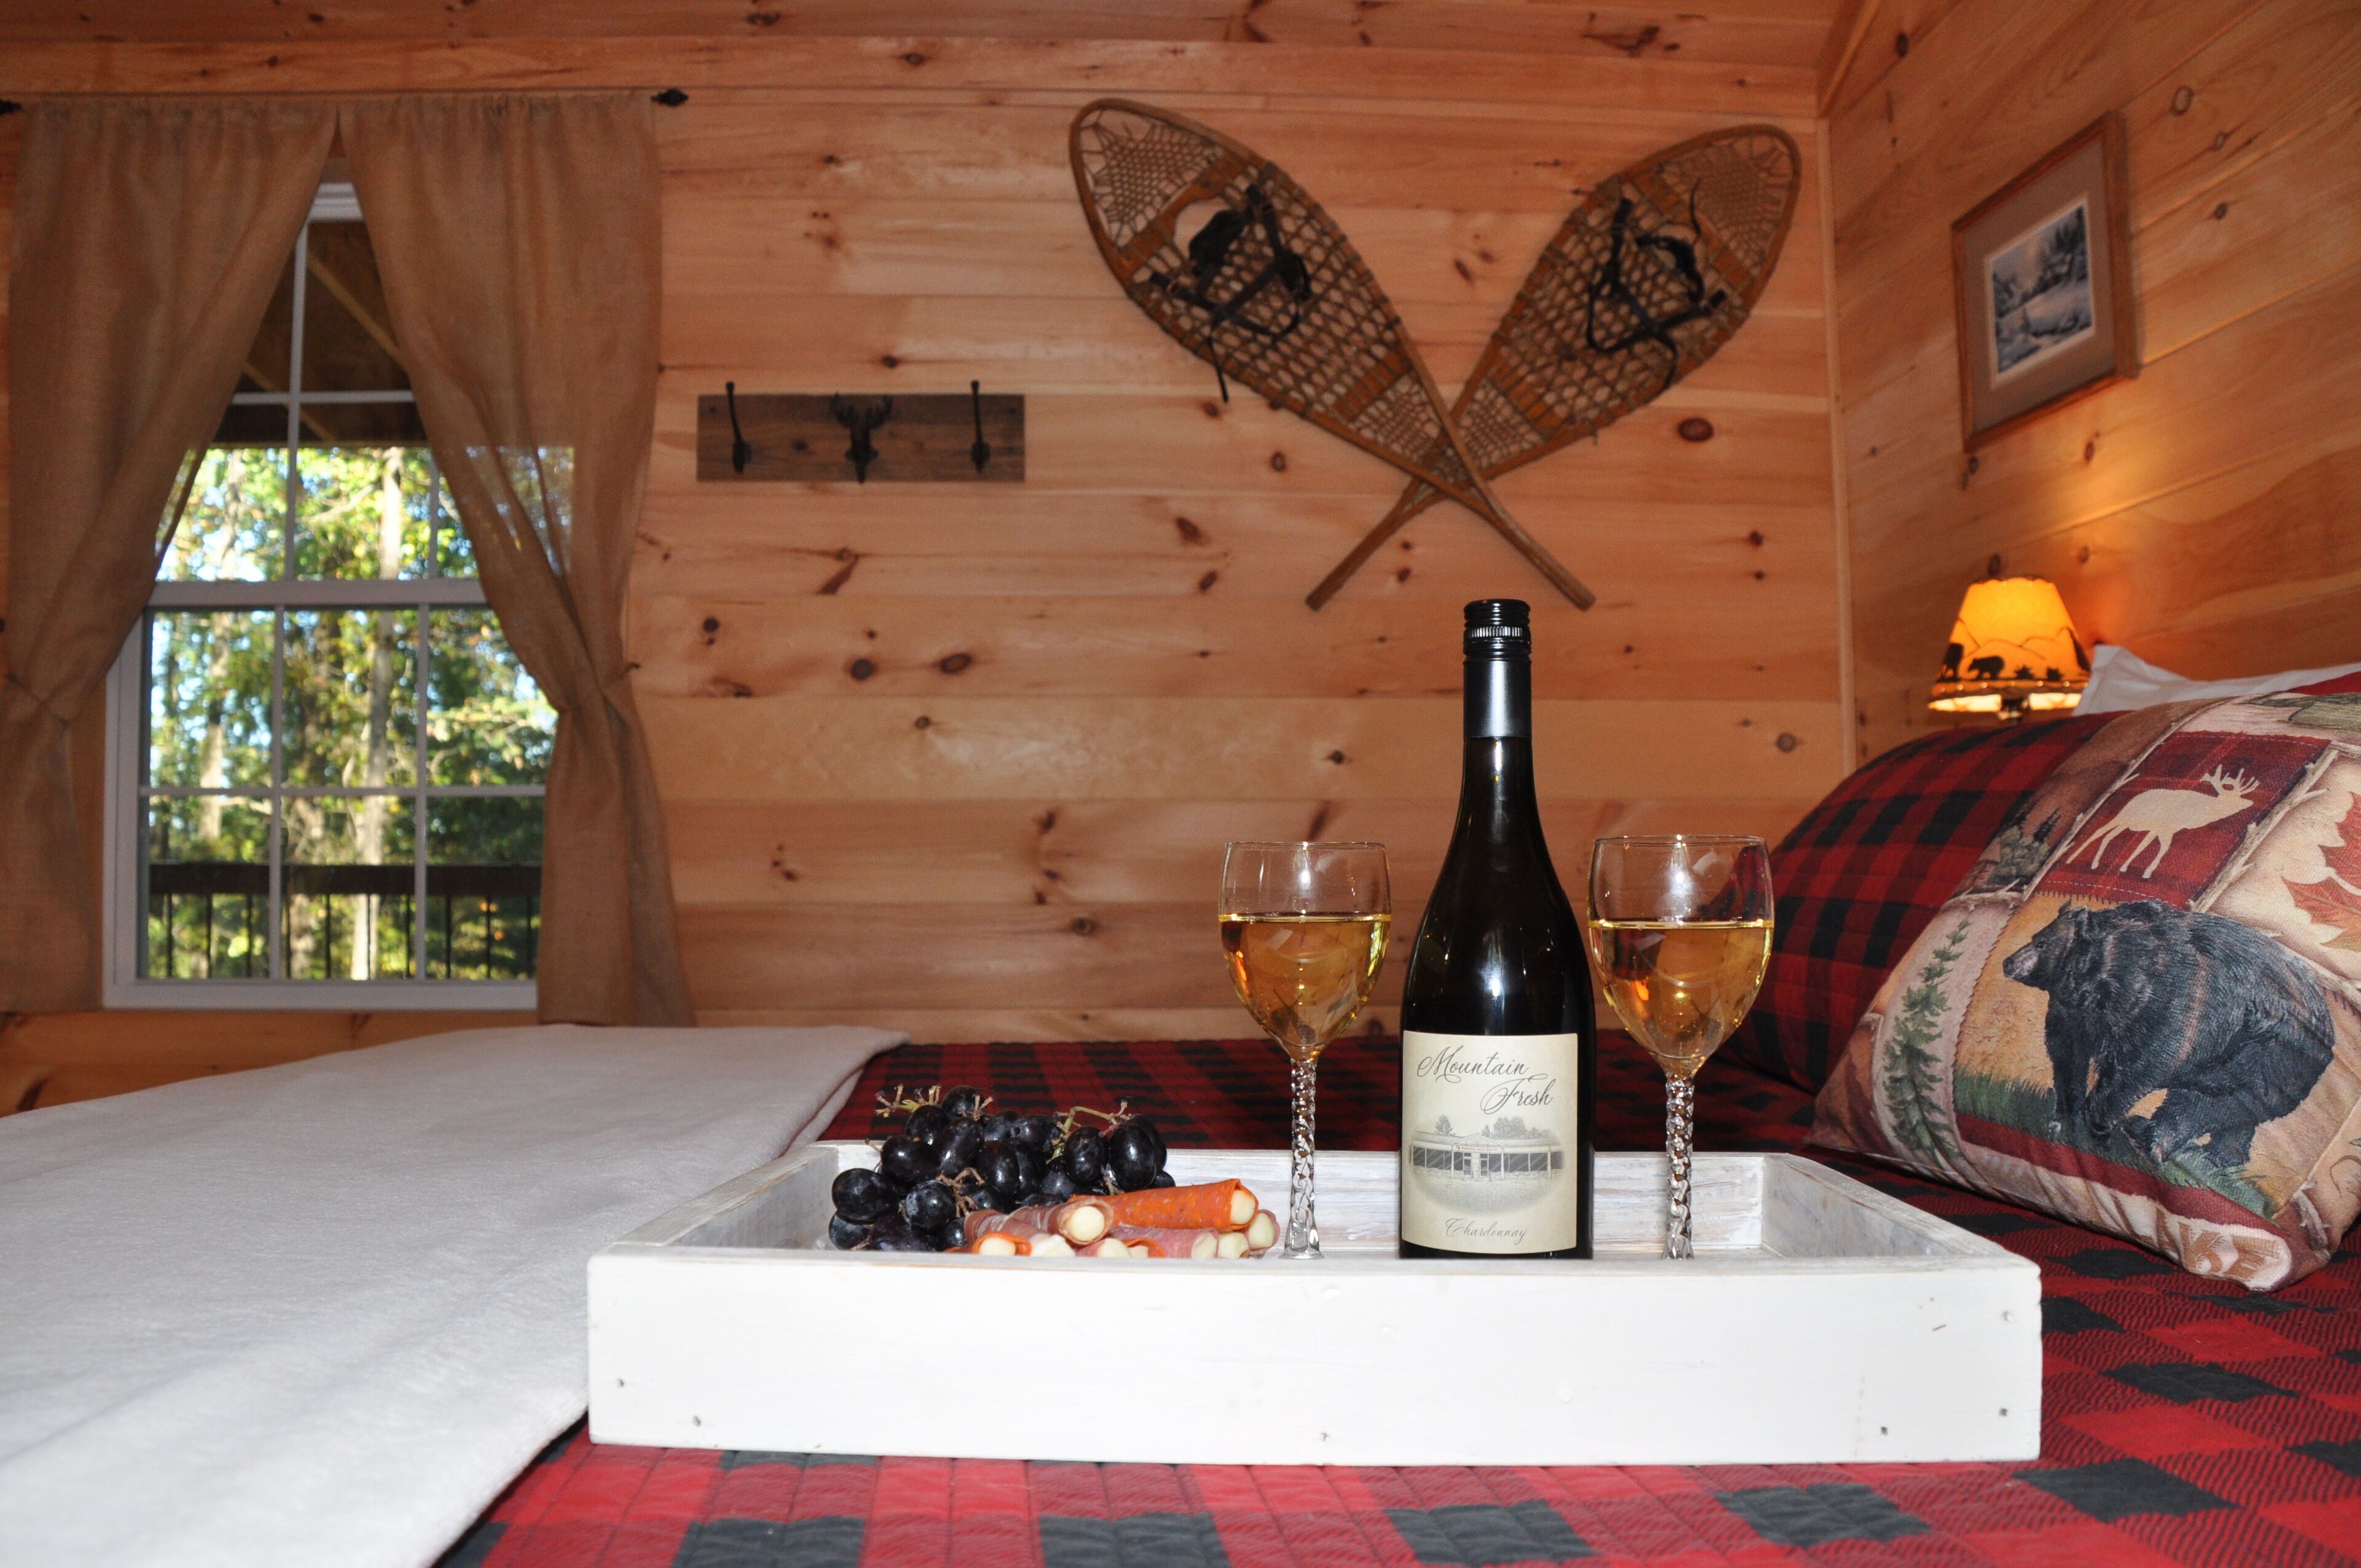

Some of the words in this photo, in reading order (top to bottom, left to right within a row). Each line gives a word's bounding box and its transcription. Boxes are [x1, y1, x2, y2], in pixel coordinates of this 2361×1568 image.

[1417, 1045, 1529, 1083] Mountain
[1480, 1074, 1556, 1115] Fresh
[1445, 1218, 1529, 1246] Chardonnay
